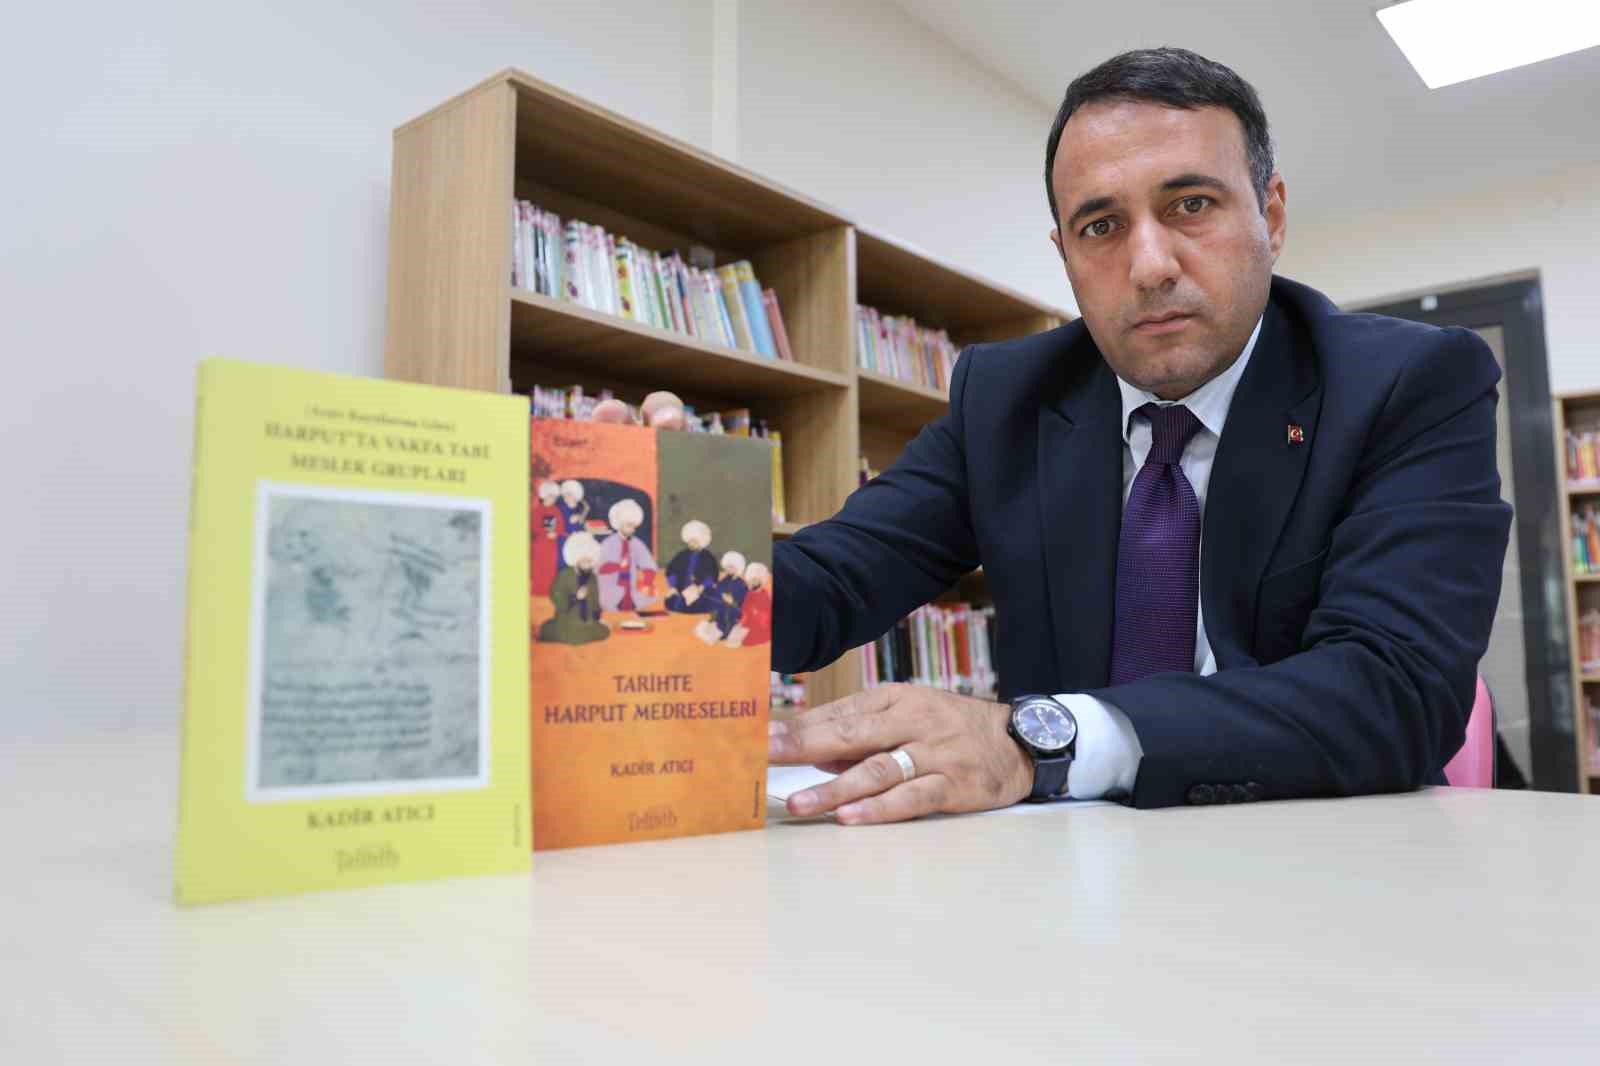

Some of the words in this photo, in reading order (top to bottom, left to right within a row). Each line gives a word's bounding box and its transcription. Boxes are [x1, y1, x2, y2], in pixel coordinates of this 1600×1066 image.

[289, 452, 365, 475] MESLEK
[370, 462, 466, 483] GRUPLARI
[613, 674, 693, 694] TARİHTE
[544, 704, 627, 725] HARPUT
[632, 697, 757, 721] MEDRESELERİ
